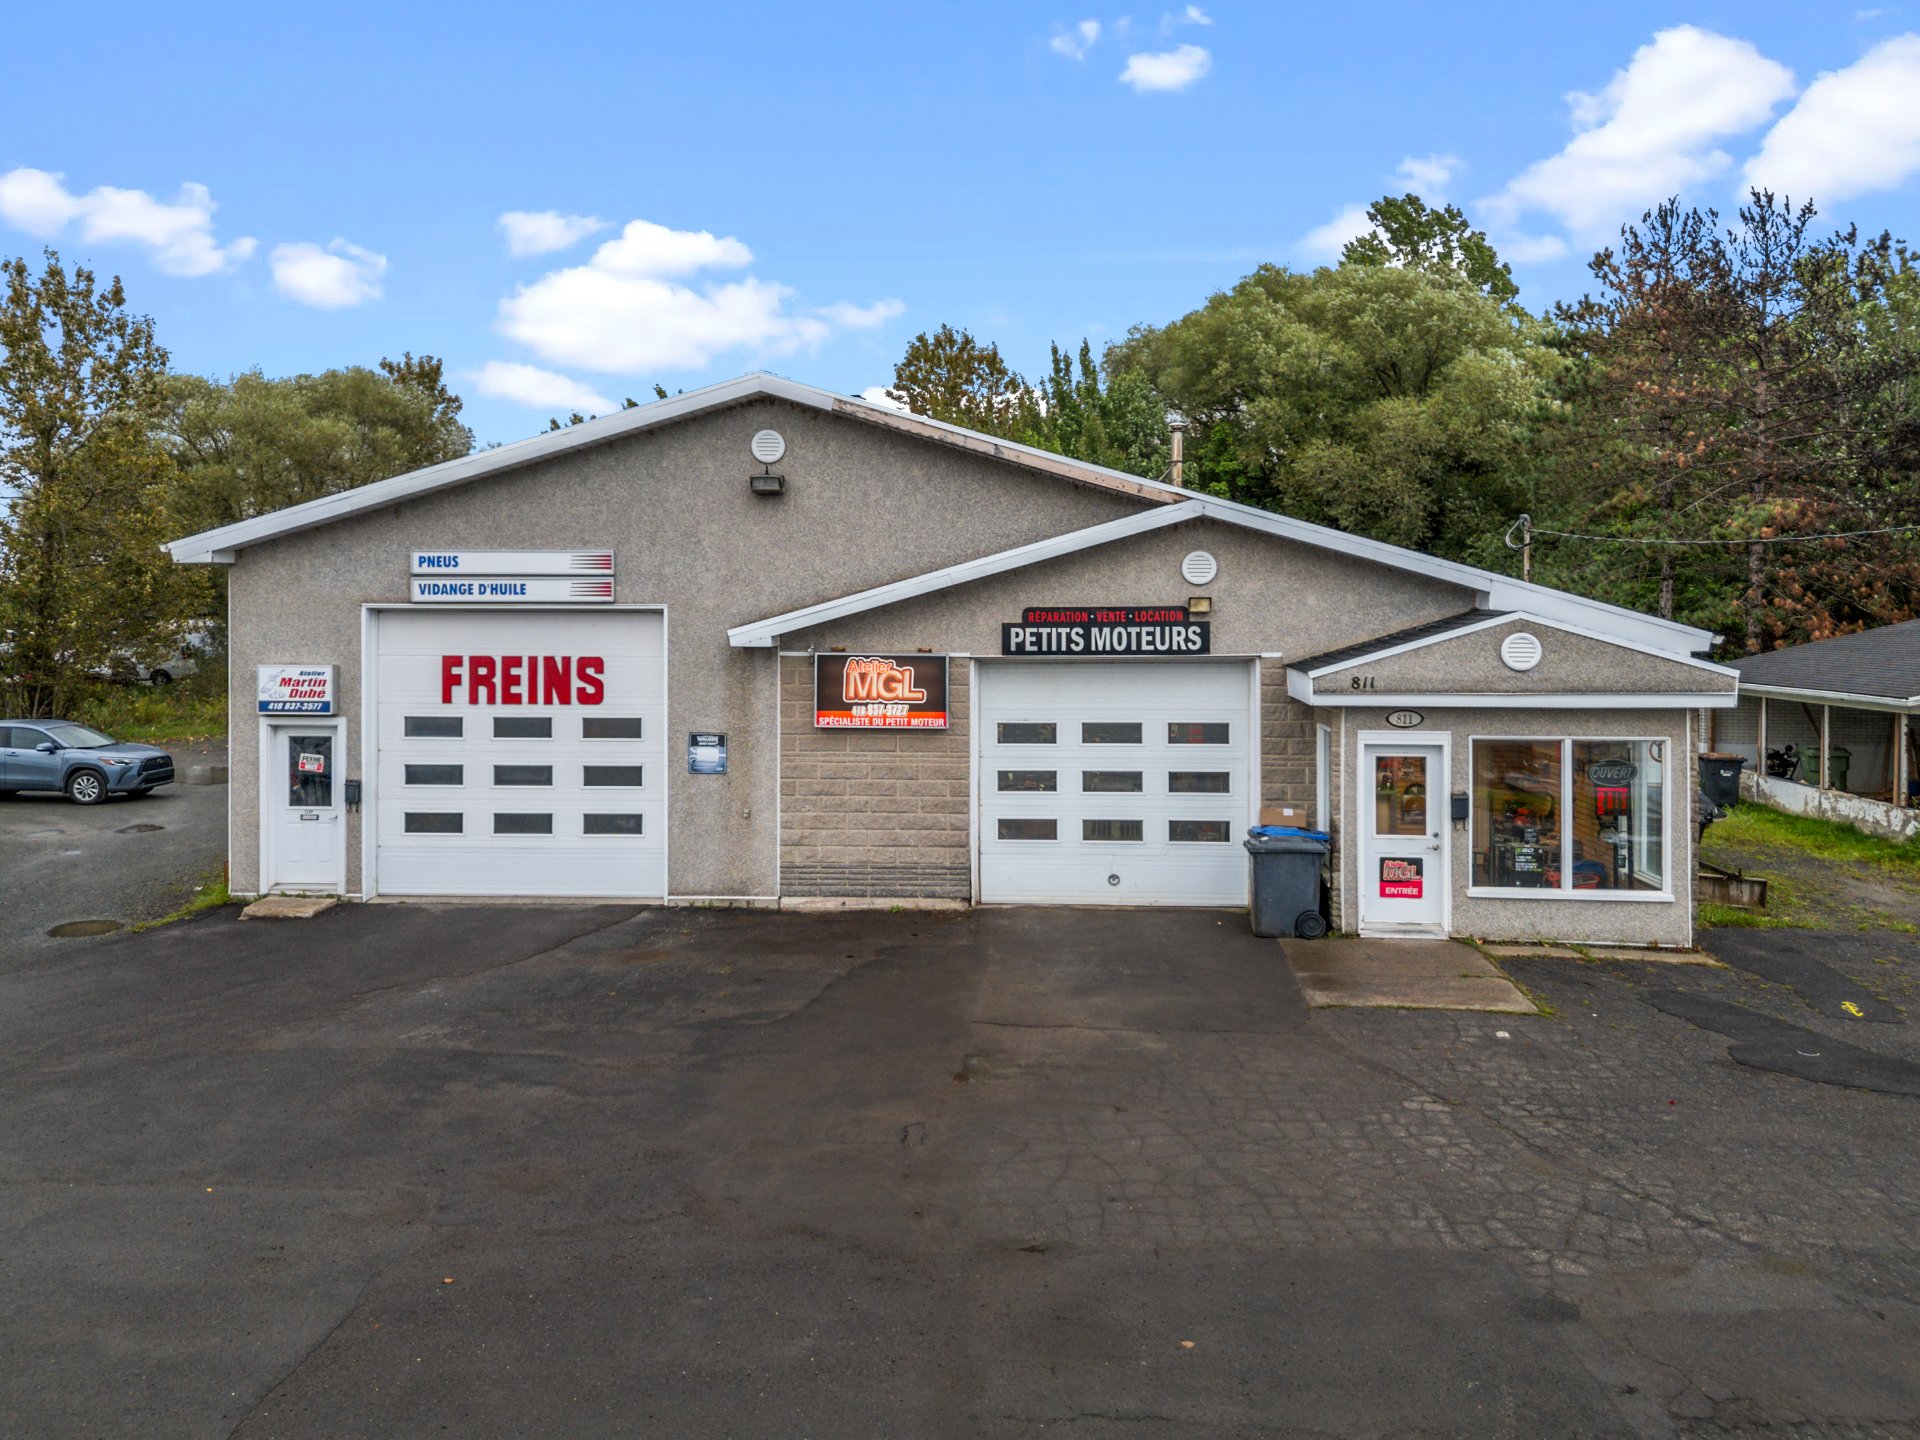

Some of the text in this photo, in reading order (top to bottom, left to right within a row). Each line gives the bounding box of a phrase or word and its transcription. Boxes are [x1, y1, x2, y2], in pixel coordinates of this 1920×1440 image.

[418, 555, 459, 568] PNEUS
[418, 583, 527, 595] VIDANGE D'HUILE
[1028, 610, 1183, 623] RÉPARATION VENTE LOCATION
[1010, 625, 1202, 652] PETITS MOTEURS
[846, 659, 894, 673] Atelier
[279, 677, 327, 688] Martin
[442, 655, 605, 705] FREINS
[845, 669, 924, 700] MGL
[1351, 676, 1375, 690] 811
[288, 688, 326, 699] Dubé
[267, 702, 283, 710] 418
[818, 716, 945, 727] SPÉCIALISTE DU PETIT MOTEUR
[1591, 766, 1633, 779] OUVERT
[1383, 866, 1421, 881] MGL
[1385, 886, 1419, 896] ENTRÉE
